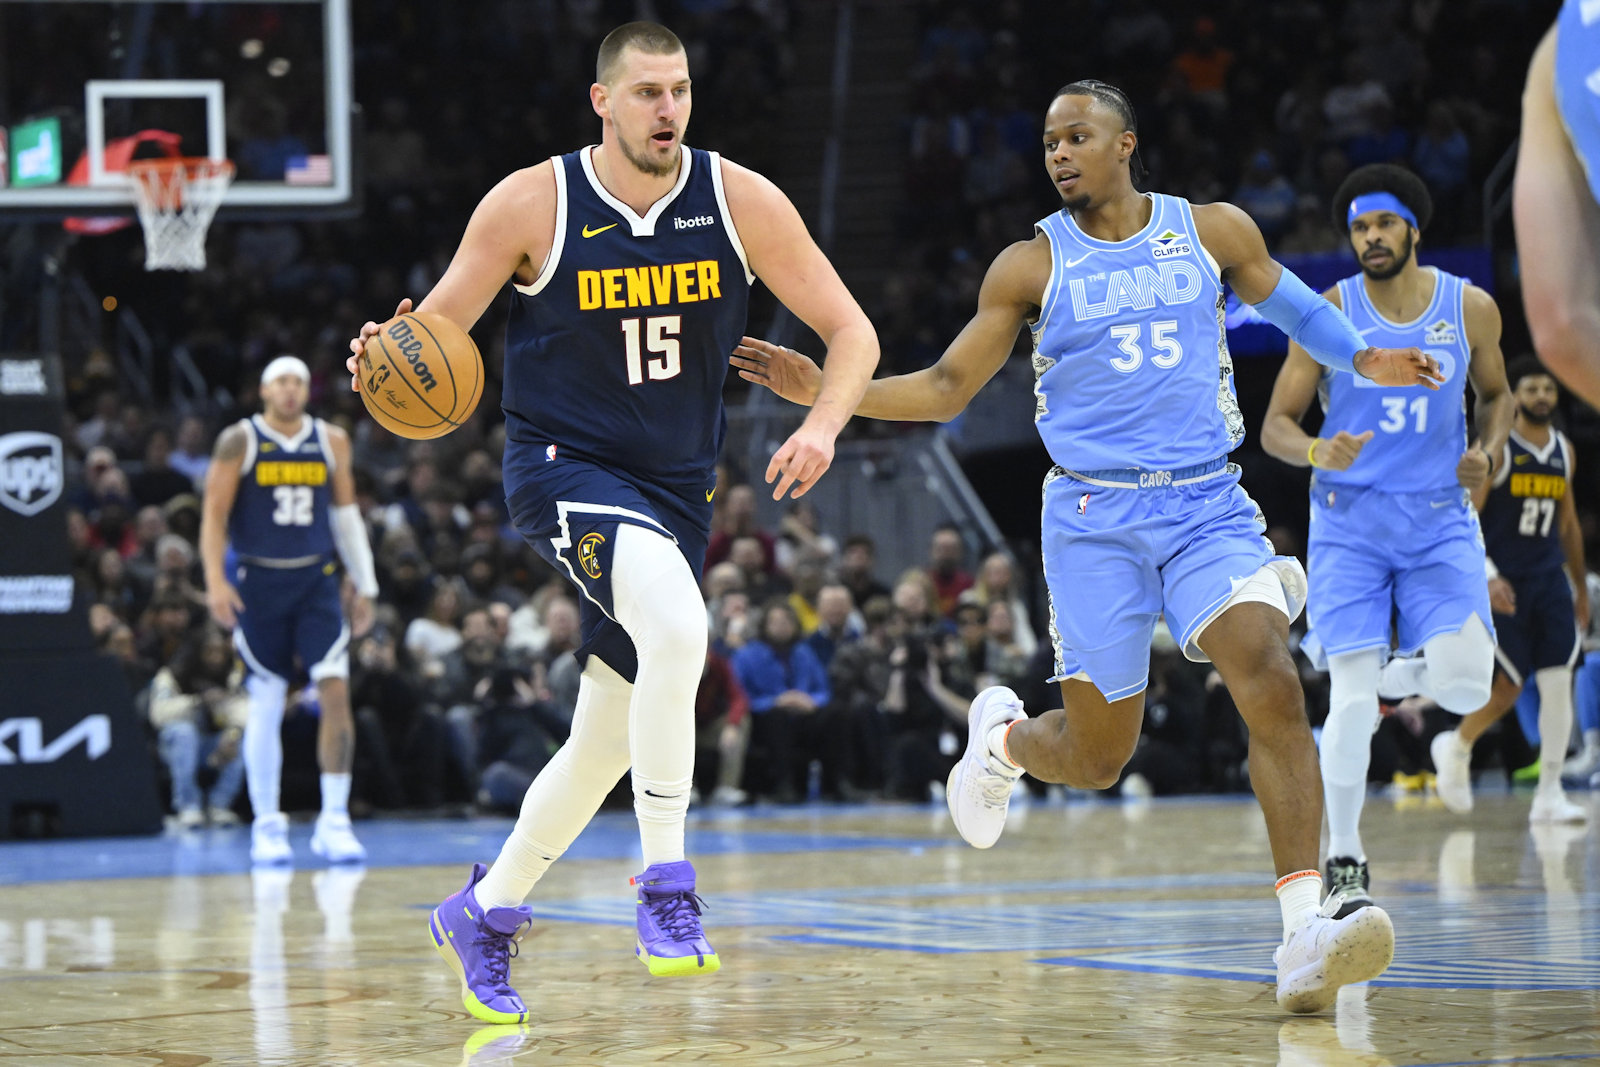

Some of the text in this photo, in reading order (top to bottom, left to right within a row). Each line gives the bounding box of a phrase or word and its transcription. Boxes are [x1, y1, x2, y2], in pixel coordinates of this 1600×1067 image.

[674, 215, 714, 230] ibotta
[1154, 245, 1190, 257] CLIFFS
[577, 260, 722, 310] DENVER
[1069, 260, 1202, 322] LAND
[1087, 272, 1107, 283] THE
[387, 319, 438, 394] Wilson
[621, 314, 682, 386] 15
[1109, 320, 1183, 374] 35
[1378, 395, 1429, 434] 31
[256, 461, 328, 487] DENVER
[1139, 471, 1172, 488] CAVS
[1510, 472, 1567, 500] DENVER
[272, 485, 314, 526] 32
[1518, 497, 1556, 537] 27
